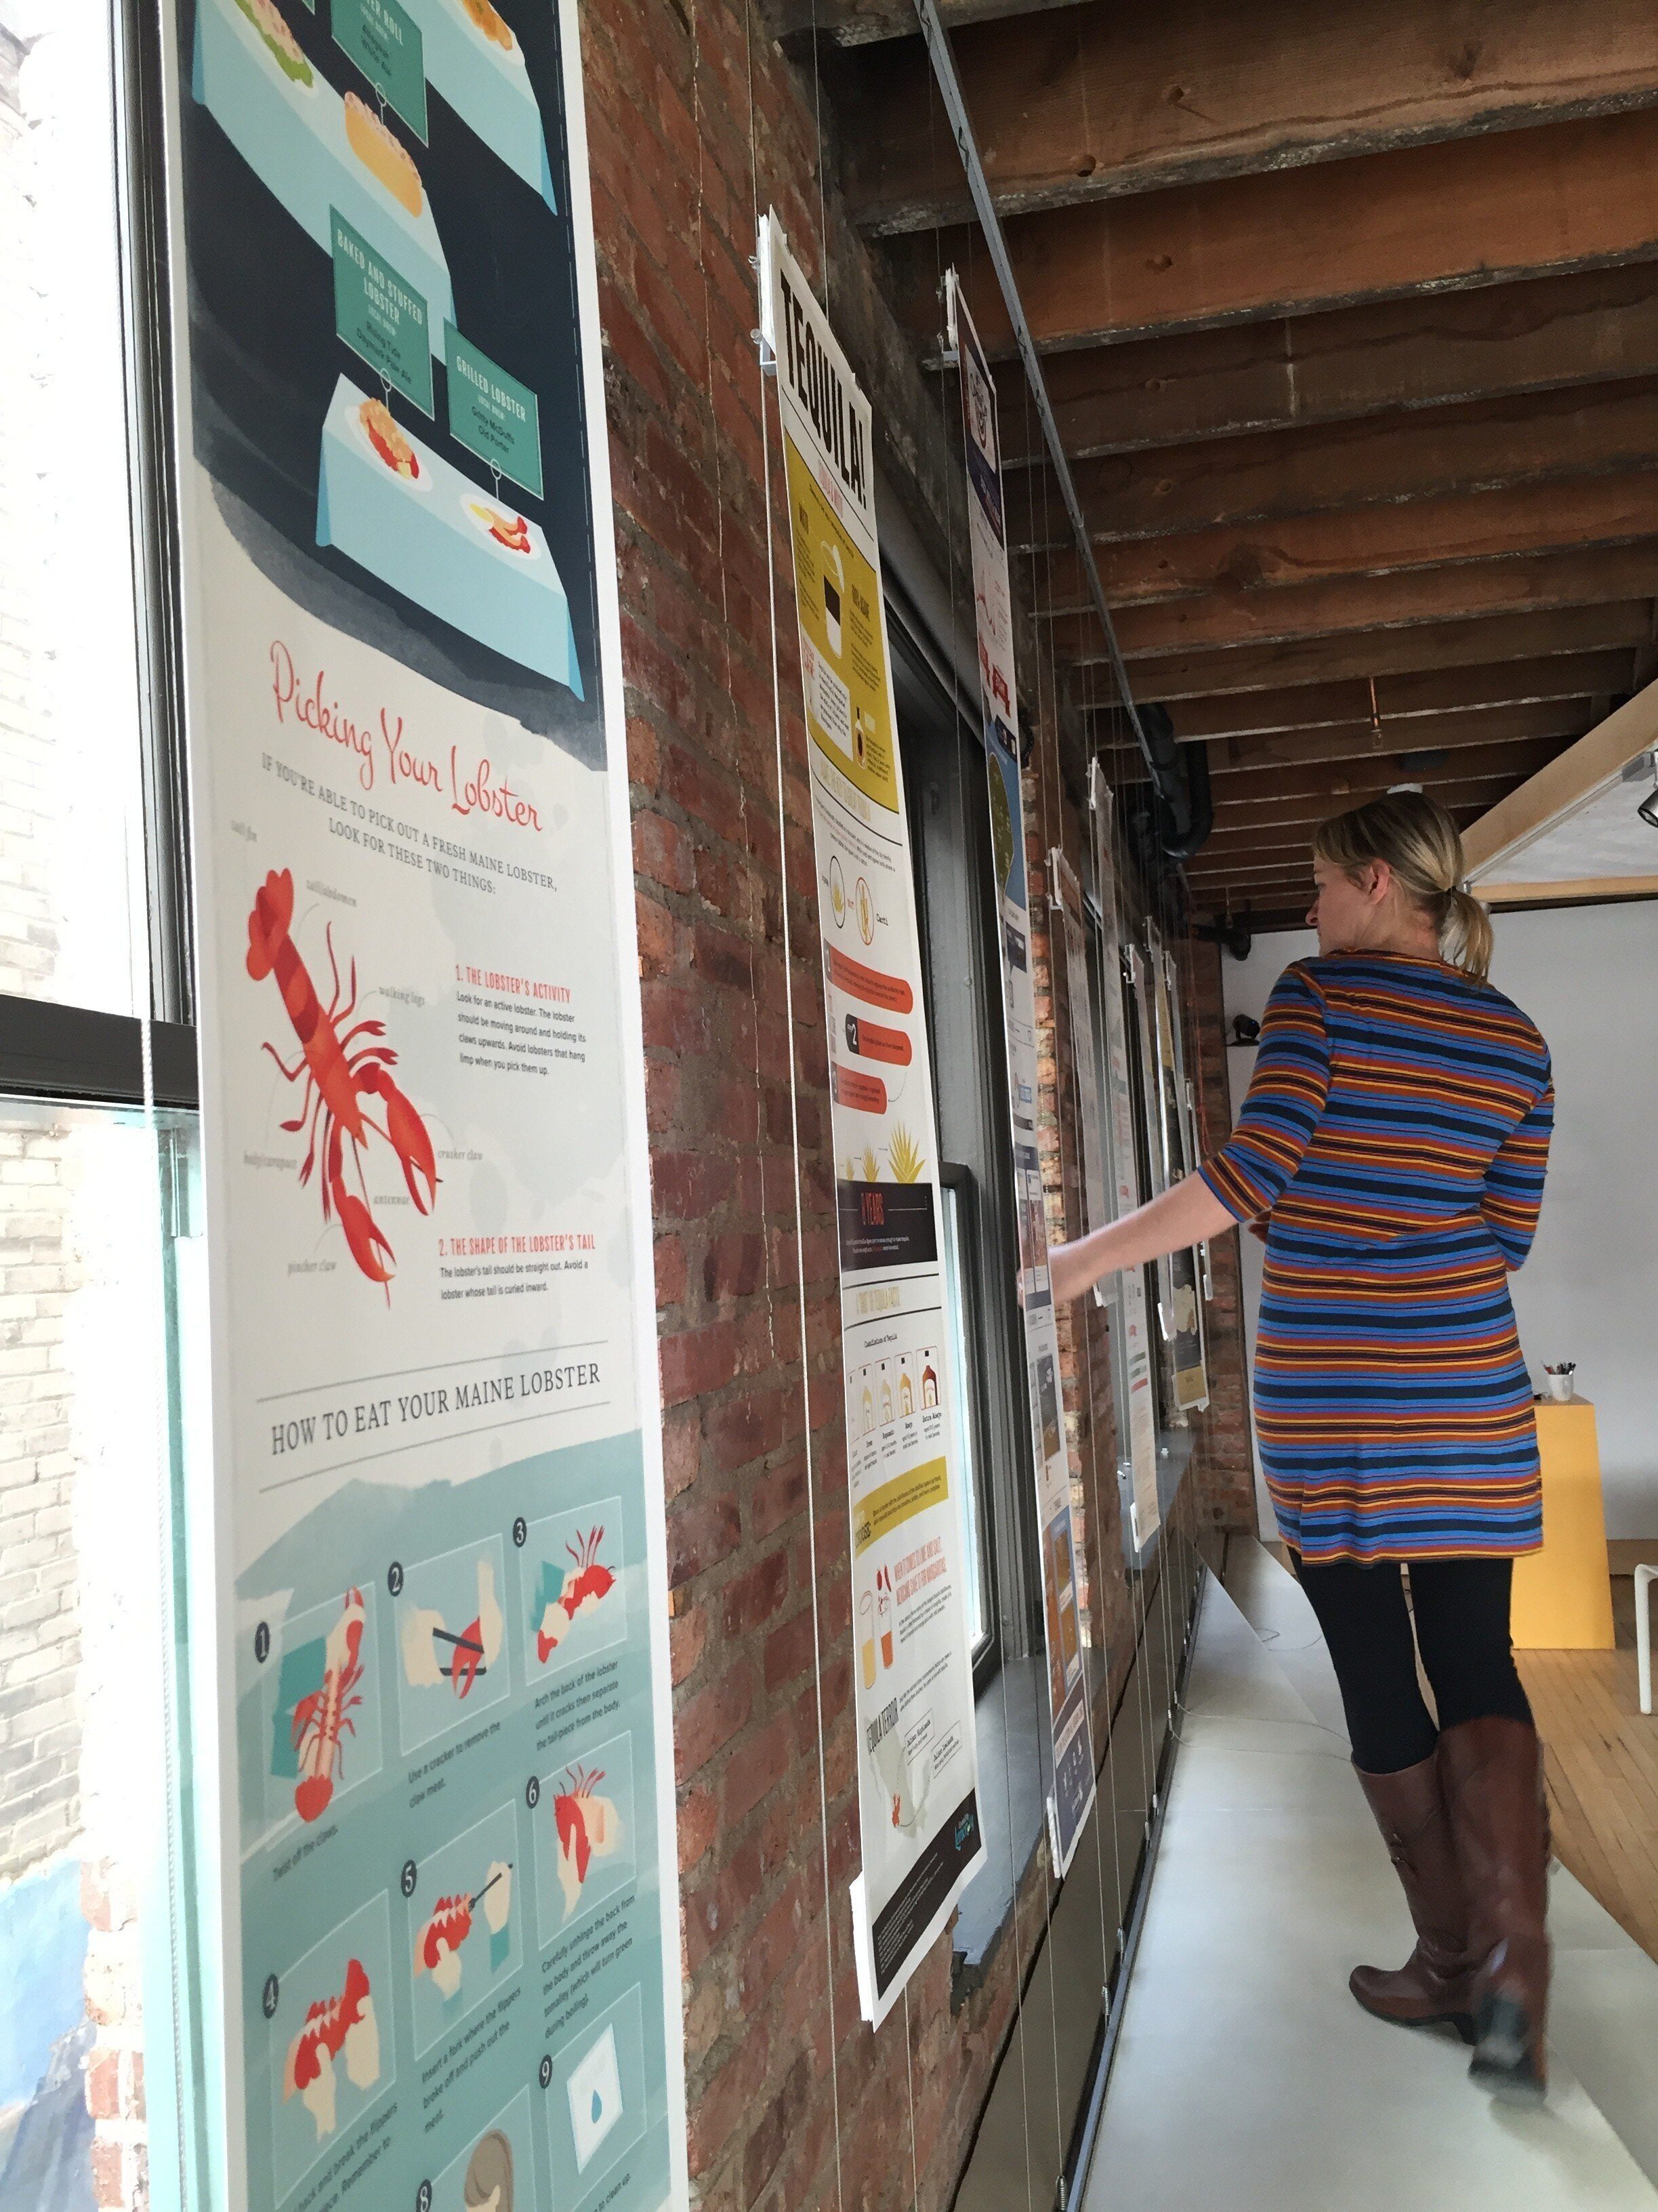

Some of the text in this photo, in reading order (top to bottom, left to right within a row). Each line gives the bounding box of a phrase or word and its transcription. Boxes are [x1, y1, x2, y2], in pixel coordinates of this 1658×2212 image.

[337, 228, 422, 325] BAKED AND STUFFED
[364, 277, 400, 325] LOBSTER
[457, 356, 526, 422] GRILLED LOBSTER
[780, 268, 867, 510] TEQUILA!
[270, 640, 543, 832] Picking Your Lobster
[262, 752, 558, 892] IF YOU'RE ABLE TO PICK OUT A FRESH MAINE LOBSTER,
[329, 817, 496, 894] LOOK FOR THESE TWO THINGS:
[455, 964, 571, 1004] 1. THE LOBSTER'S ACTIVITY
[457, 991, 575, 1023] Look for an active lobster. The lobster
[458, 1012, 586, 1044] should be moving around and holding its
[459, 1033, 585, 1063] claws upwards. Avoid lobsters that hang
[459, 1052, 550, 1076] limp when you pick them up.
[438, 1233, 596, 1256] 2. THE SHAPE OF THE LOBSTER'S TAIL
[440, 1267, 453, 1277] The
[454, 1265, 481, 1277] lobster's
[482, 1265, 493, 1275] tail
[494, 1263, 514, 1275] should
[516, 1263, 524, 1273] be
[525, 1261, 549, 1274] straight
[564, 1259, 583, 1270] Avoid
[584, 1261, 589, 1269] a
[441, 1289, 463, 1300] lobster
[465, 1288, 485, 1298] whose
[486, 1286, 497, 1296] tail
[498, 1286, 503, 1294] is
[505, 1283, 524, 1294] curled
[271, 1362, 601, 1455] HOW TO EAT YOUR MAINE LOBSTER
[516, 1522, 524, 1543] 3
[392, 1568, 400, 1591] 2
[257, 1630, 267, 1655] 1
[535, 1662, 618, 1709] Arch the back of the lobster
[556, 1681, 619, 1719] cracks then separate
[537, 1708, 603, 1750] the from the
[409, 1721, 500, 1784] Use a cracker to remove the
[409, 1793, 426, 1808] claw
[529, 1782, 537, 1803] 6
[303, 1841, 315, 1857] the
[405, 1866, 414, 1891] 5
[542, 1895, 635, 1973] Carefully the back from
[615, 1938, 633, 1959] green
[543, 1921, 628, 1995] the body and throw away the
[265, 1982, 276, 2011] 4
[421, 1986, 522, 2084] Insert a fork where the flippers
[545, 2015, 564, 2039] during
[423, 2021, 510, 2110] broke off and push out the
[541, 2060, 550, 2083] 9
[356, 2131, 369, 2150] the
[419, 2185, 429, 2211] 8
[606, 2182, 621, 2203] clean
